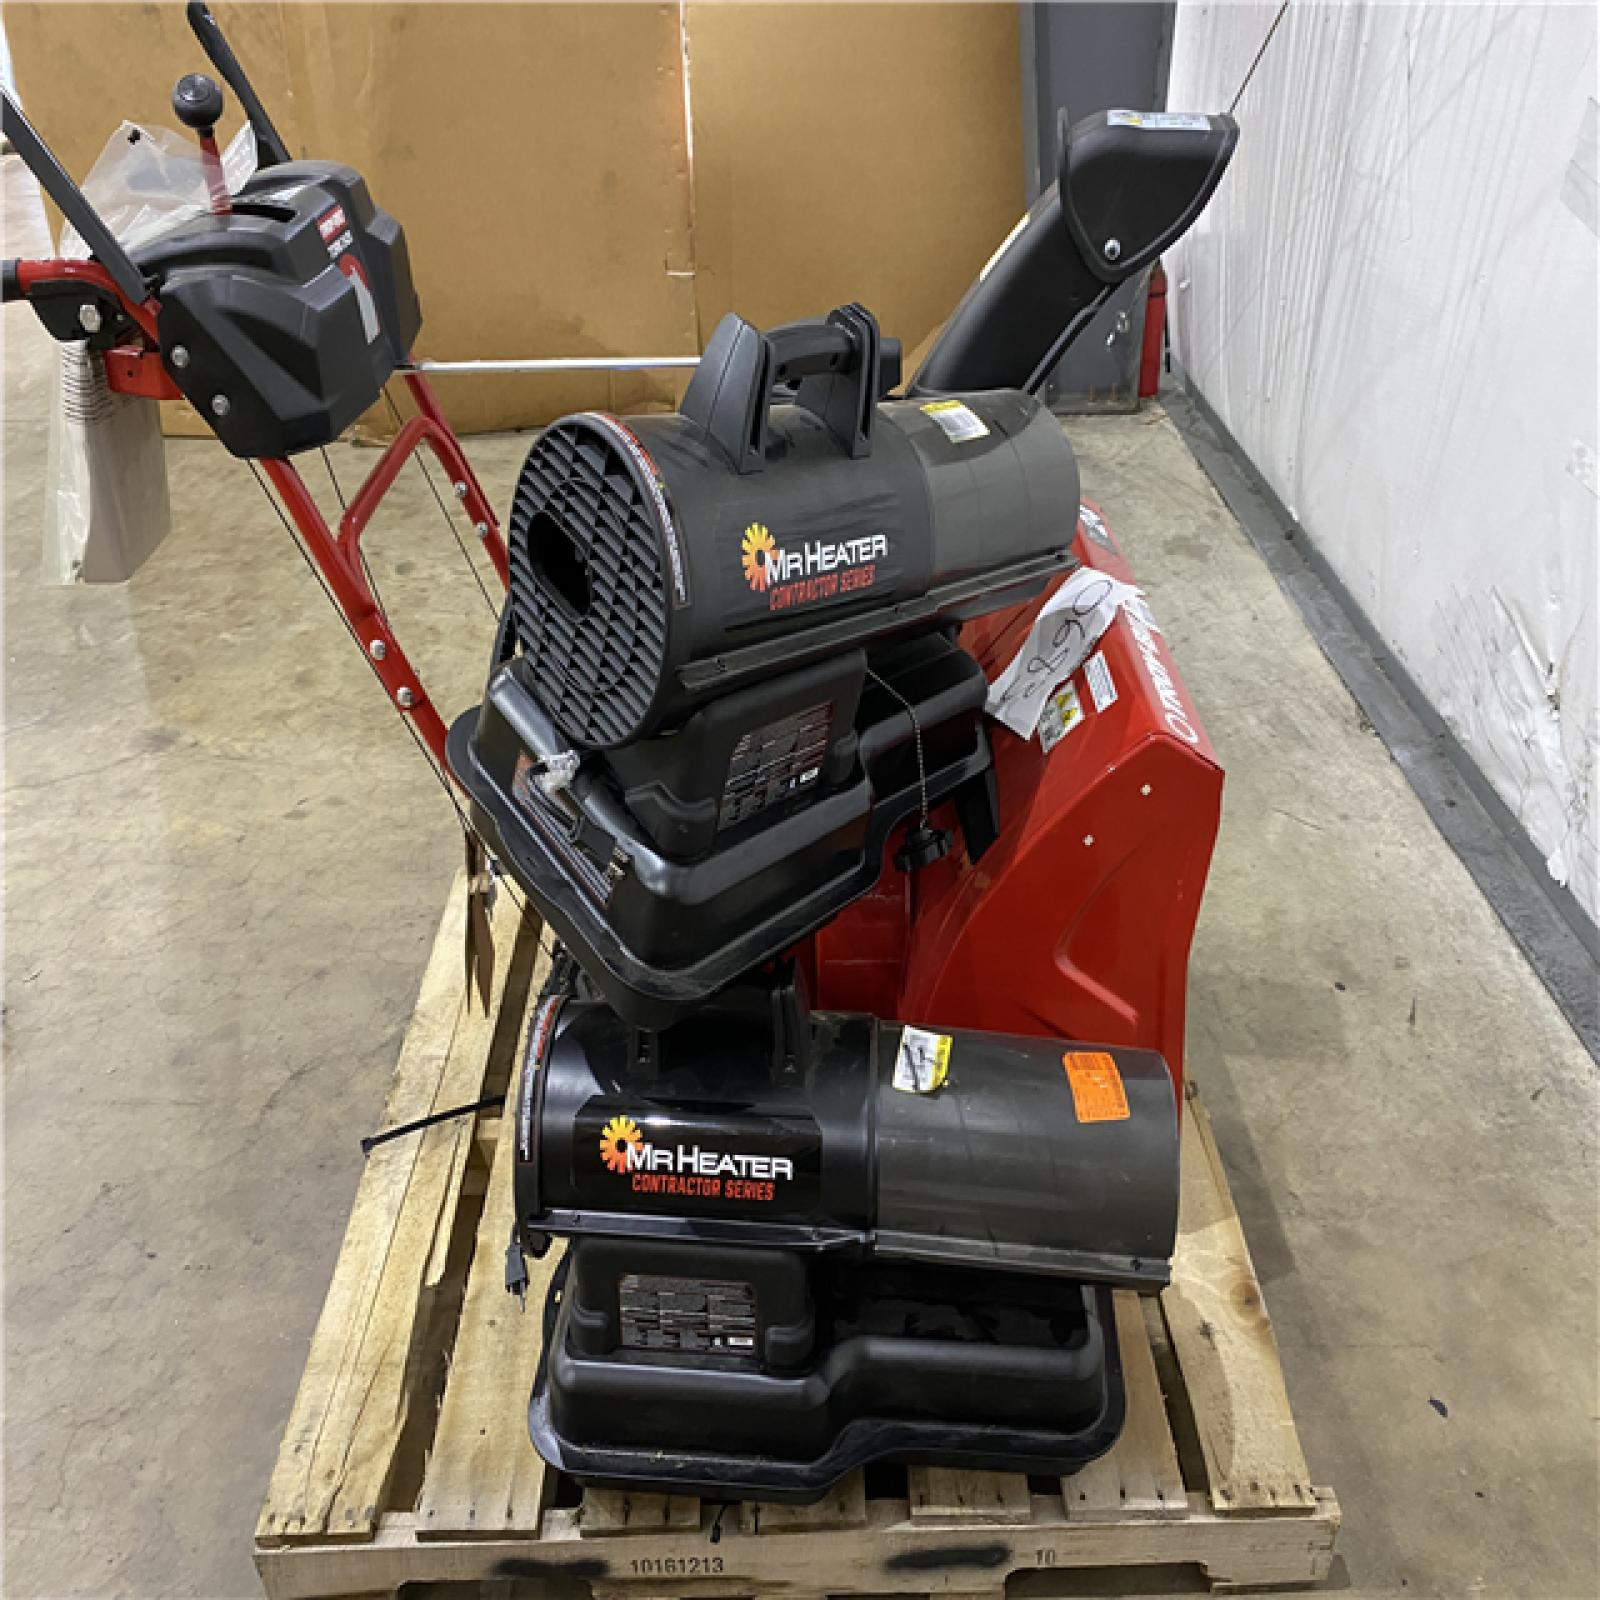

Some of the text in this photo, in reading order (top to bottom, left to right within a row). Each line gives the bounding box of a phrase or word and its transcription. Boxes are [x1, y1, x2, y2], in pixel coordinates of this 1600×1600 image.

[805, 533, 888, 575] HEATER
[769, 564, 876, 611] CONTRACTOR SERIES
[677, 1144, 794, 1181] HEATER
[631, 1173, 777, 1201] CONTRACTOR SERIES
[629, 1556, 724, 1574] 10161213
